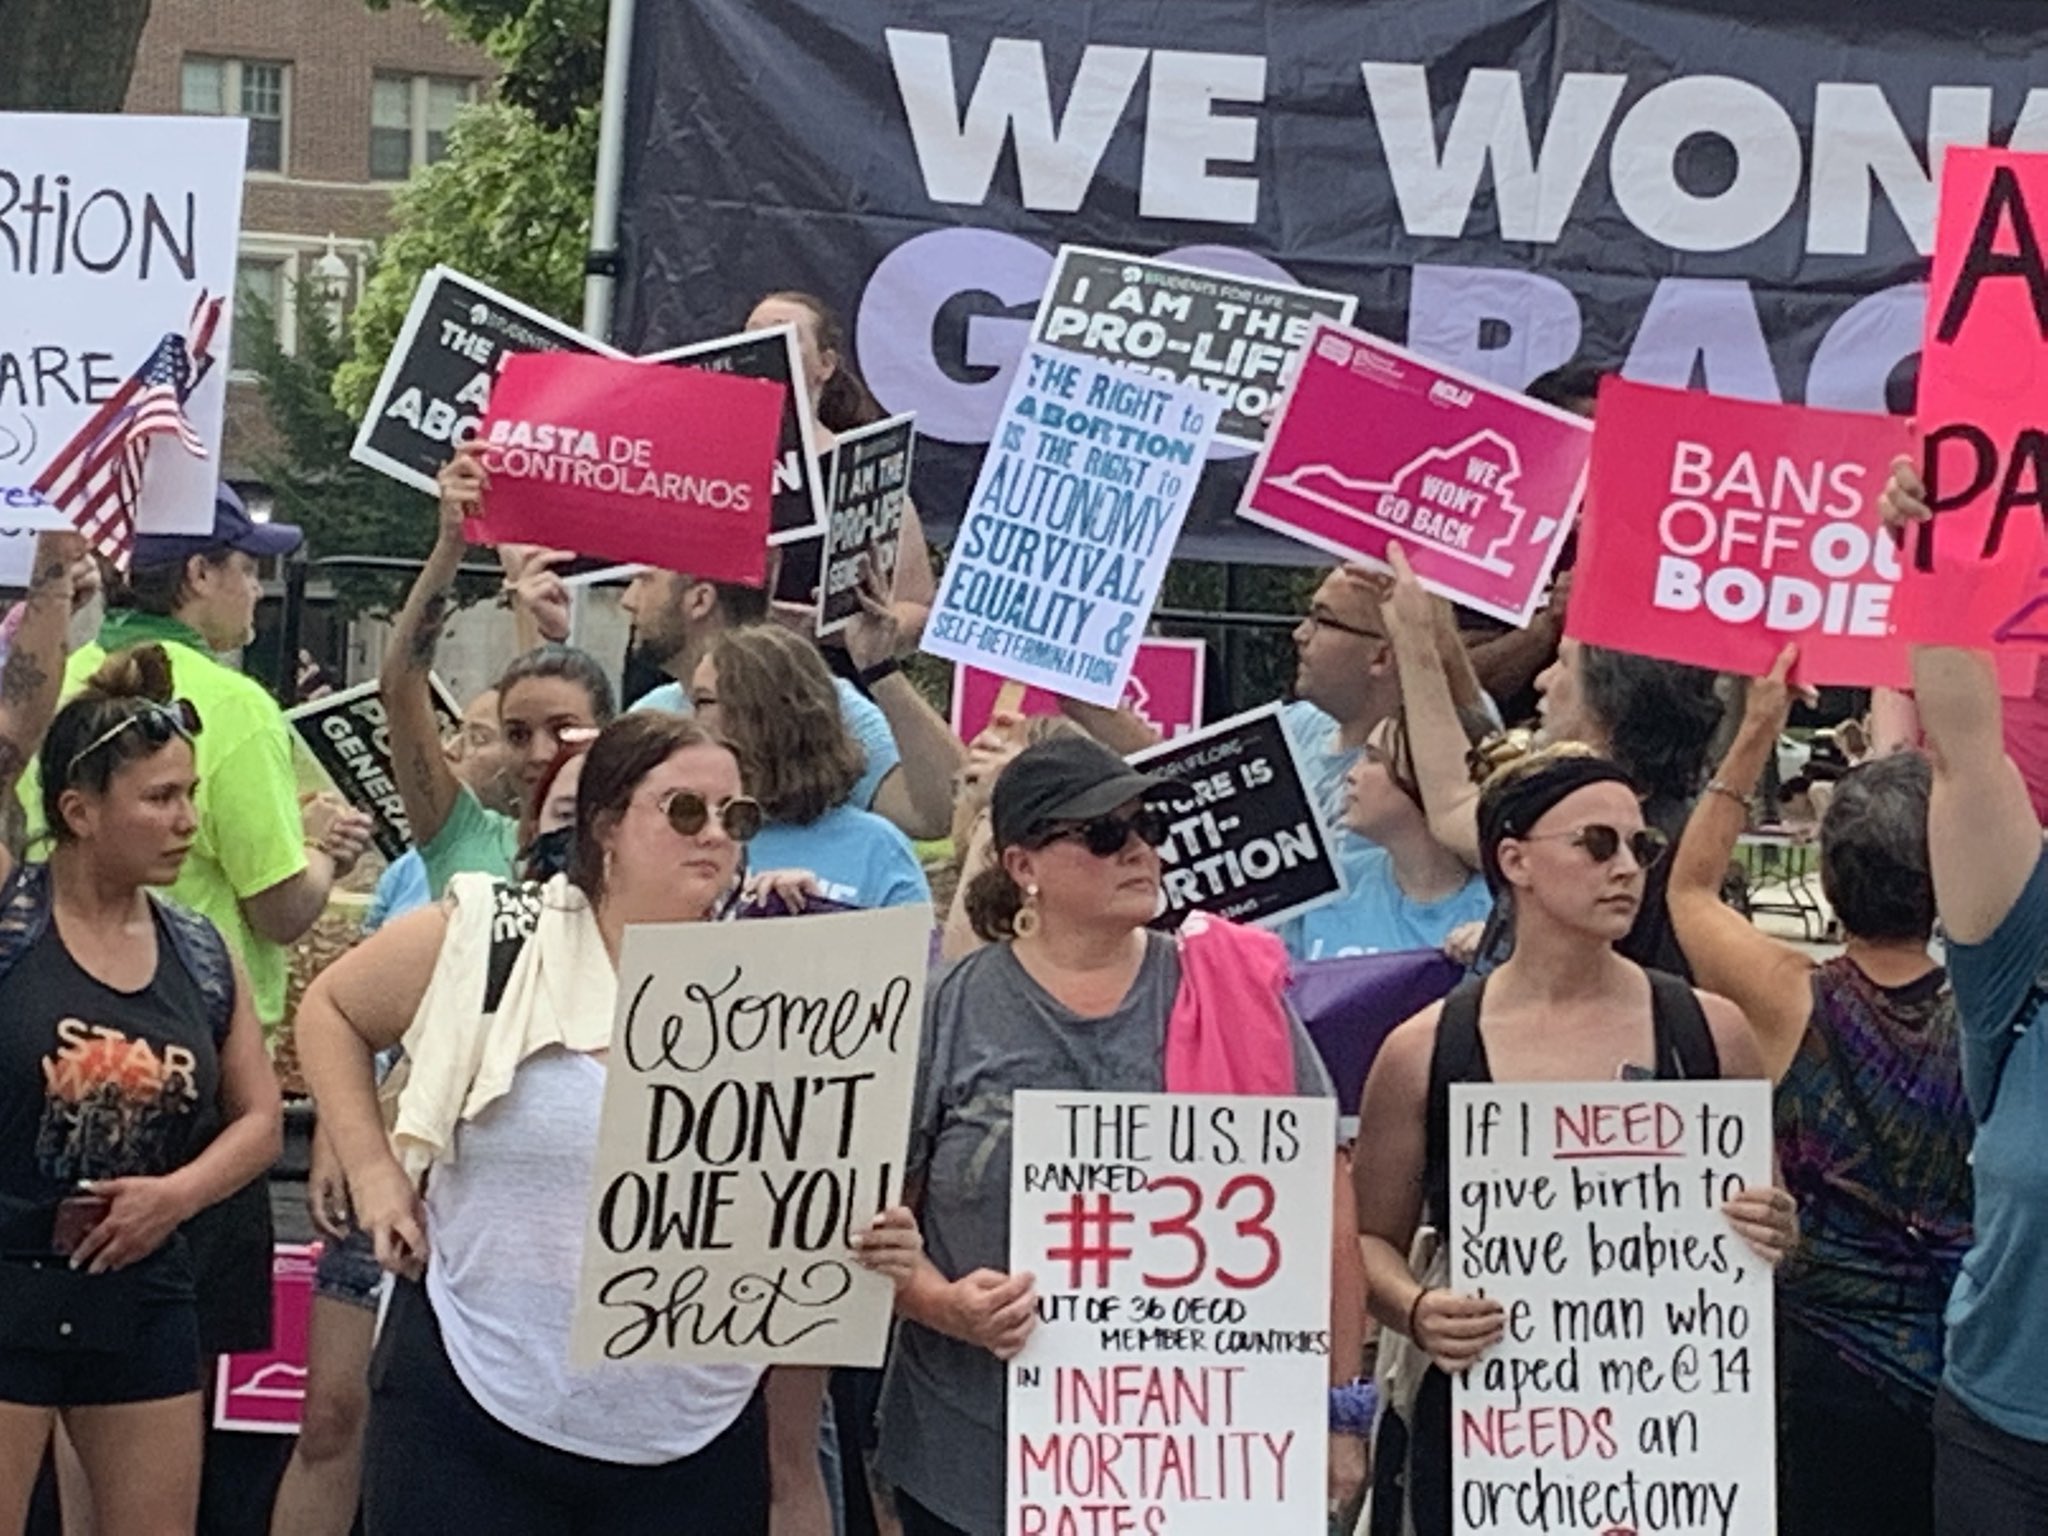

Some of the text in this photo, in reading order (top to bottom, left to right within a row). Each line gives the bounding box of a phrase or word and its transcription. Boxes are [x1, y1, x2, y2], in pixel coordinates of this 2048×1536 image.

[885, 28, 1267, 224] WE
[1072, 277, 1311, 346] I AM THE
[1145, 273, 1284, 308] STUDENTS FOR LIFE
[441, 318, 495, 365] THE
[1029, 354, 1204, 436] THE RIGHT to
[488, 420, 652, 468] BASTA DE
[1001, 422, 1026, 452] IS
[1036, 431, 1079, 469] THE
[1084, 447, 1151, 490] RIGHT
[1015, 395, 1197, 466] ABORTION
[482, 449, 752, 512] CONTROLARNOS
[1420, 474, 1488, 518] WON'T
[1465, 456, 1502, 486] WE
[1669, 441, 1867, 519] BANS
[980, 454, 1177, 558] AUTONOMY
[1376, 493, 1475, 549] GO BACK
[1658, 499, 1805, 569] OFF
[962, 513, 1146, 607] SURVIVAL
[944, 563, 1096, 646] EQUALITY
[1104, 610, 1135, 657] &
[1239, 757, 1274, 788] IS
[625, 965, 911, 1073] Women
[57, 1017, 199, 1100] STAR
[646, 1072, 876, 1166] DON'T
[1056, 1104, 1152, 1162] THE
[1261, 1108, 1300, 1164] IS
[1553, 1102, 1686, 1158] NEED
[1696, 1103, 1744, 1158] to
[598, 1170, 739, 1254] OWE
[1024, 1163, 1148, 1193] RANKED
[1461, 1170, 1557, 1234] give
[1571, 1163, 1680, 1213] birth
[1044, 1173, 1283, 1290] #33
[1461, 1220, 1745, 1285] save babies,
[598, 1260, 853, 1360] Shit
[1037, 1295, 1246, 1324] UT OF 36 OECD
[1101, 1328, 1330, 1355] MEMBER COUNTRIES
[1553, 1298, 1644, 1343] man
[1665, 1288, 1749, 1340] who
[1017, 1366, 1245, 1426] IN INFANT
[1020, 1430, 1295, 1501] MORTALITY
[1461, 1405, 1697, 1460] NEEDS an
[1462, 1467, 1739, 1536] orchiectomy
